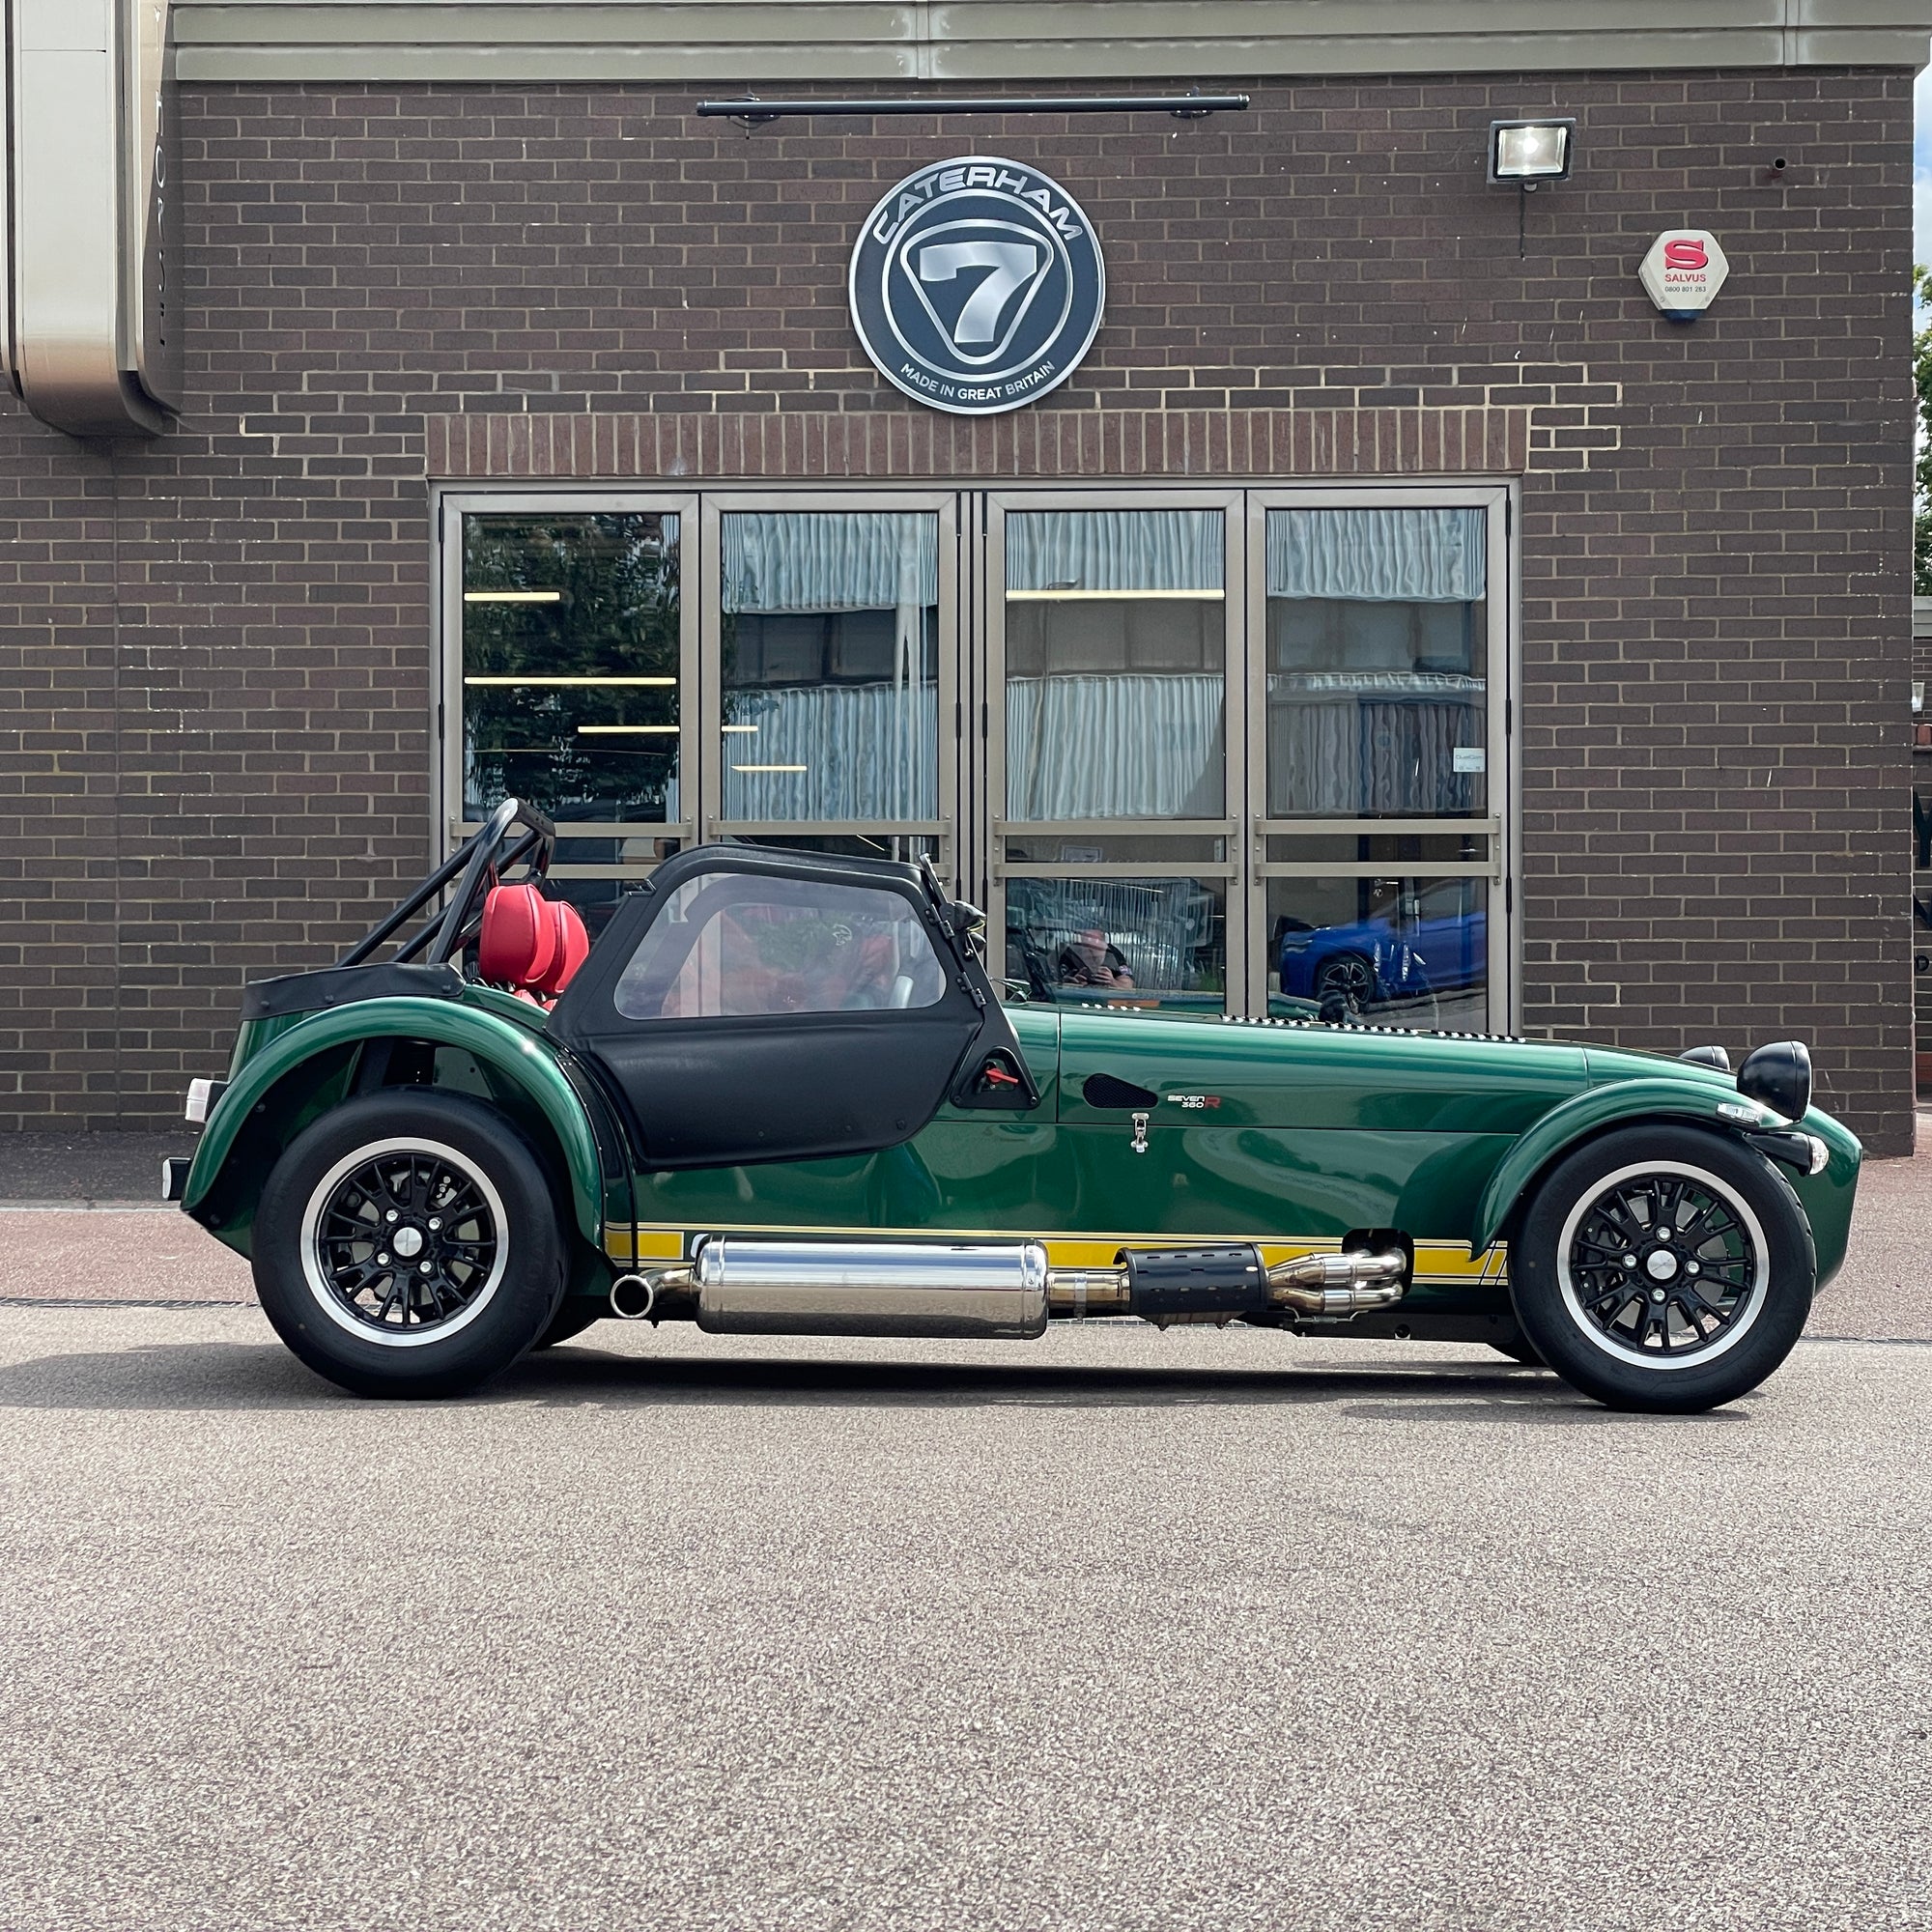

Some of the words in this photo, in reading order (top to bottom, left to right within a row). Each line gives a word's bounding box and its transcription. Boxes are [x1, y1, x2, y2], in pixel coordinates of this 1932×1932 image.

[873, 166, 1083, 244] CATERHAM
[920, 242, 1037, 343] 7
[1664, 273, 1707, 283] SALVUS
[900, 363, 939, 392] MADE
[940, 384, 955, 398] IN
[957, 386, 1003, 401] GREAT
[1005, 360, 1056, 395] BRITAIN
